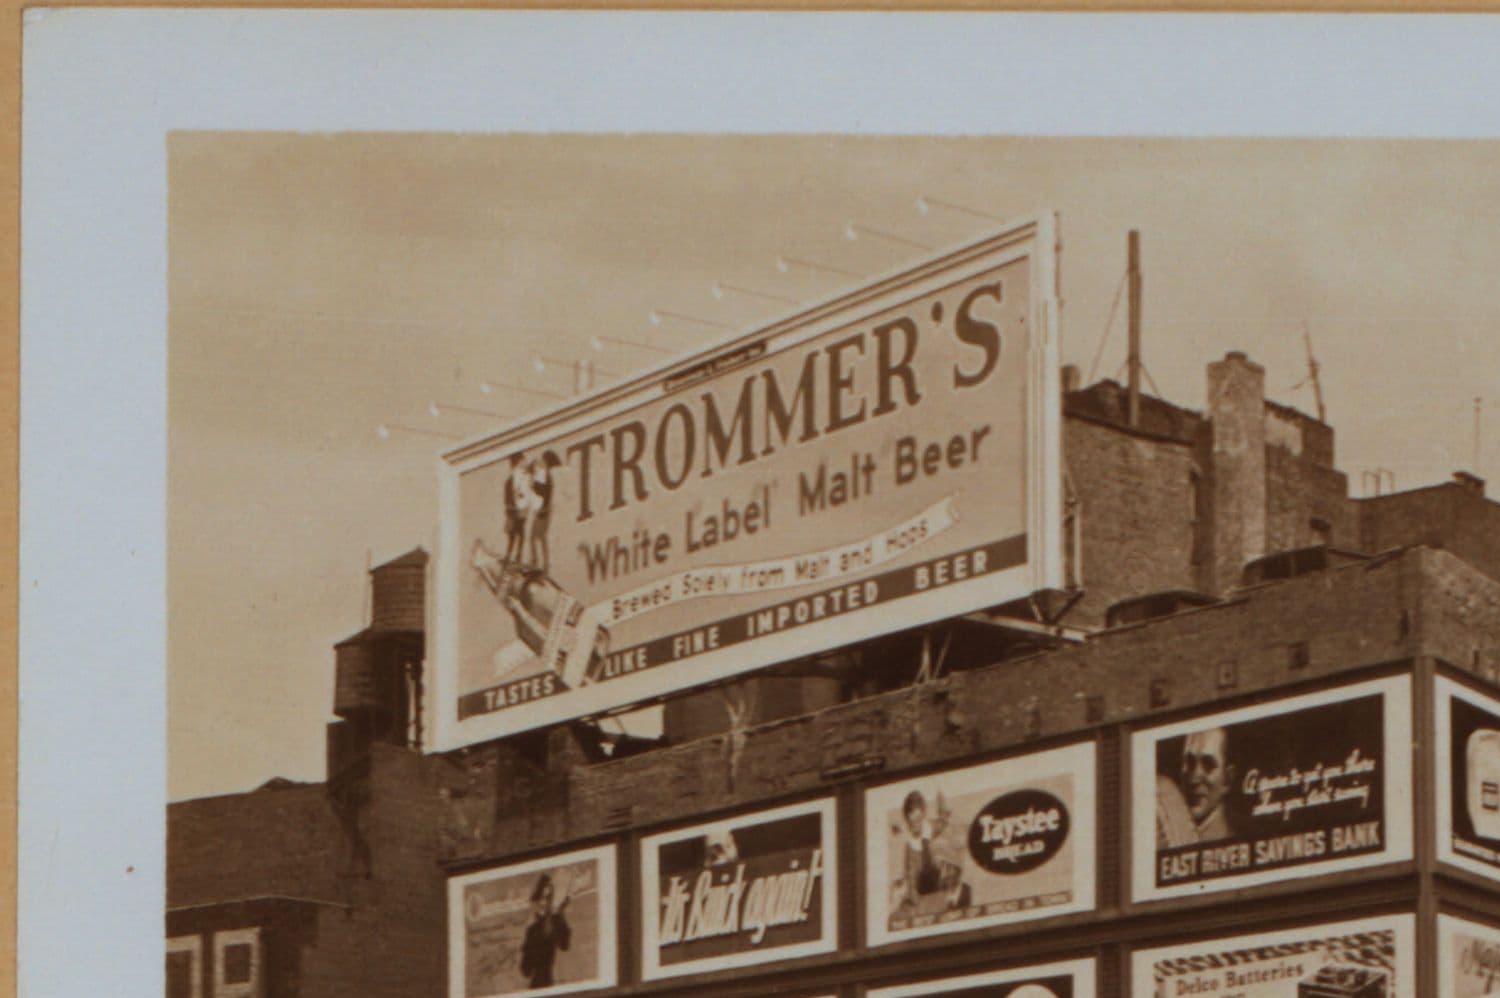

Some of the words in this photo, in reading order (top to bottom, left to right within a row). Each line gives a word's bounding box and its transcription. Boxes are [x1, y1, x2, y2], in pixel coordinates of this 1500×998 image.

[567, 283, 1004, 522] TROMMER'S
[798, 452, 875, 516] Malt
[895, 423, 991, 485] Beer
[485, 676, 555, 711] TASTES
[605, 649, 647, 677] LIKE
[674, 627, 720, 659] FINE
[747, 582, 877, 637] IMPORTED
[916, 552, 987, 591] BEER
[1160, 850, 1198, 880] EAST
[1202, 843, 1250, 873] RIVER
[1255, 830, 1326, 864] SAVINGS
[1331, 821, 1380, 850] BANK
[1225, 962, 1304, 988] Batteries
